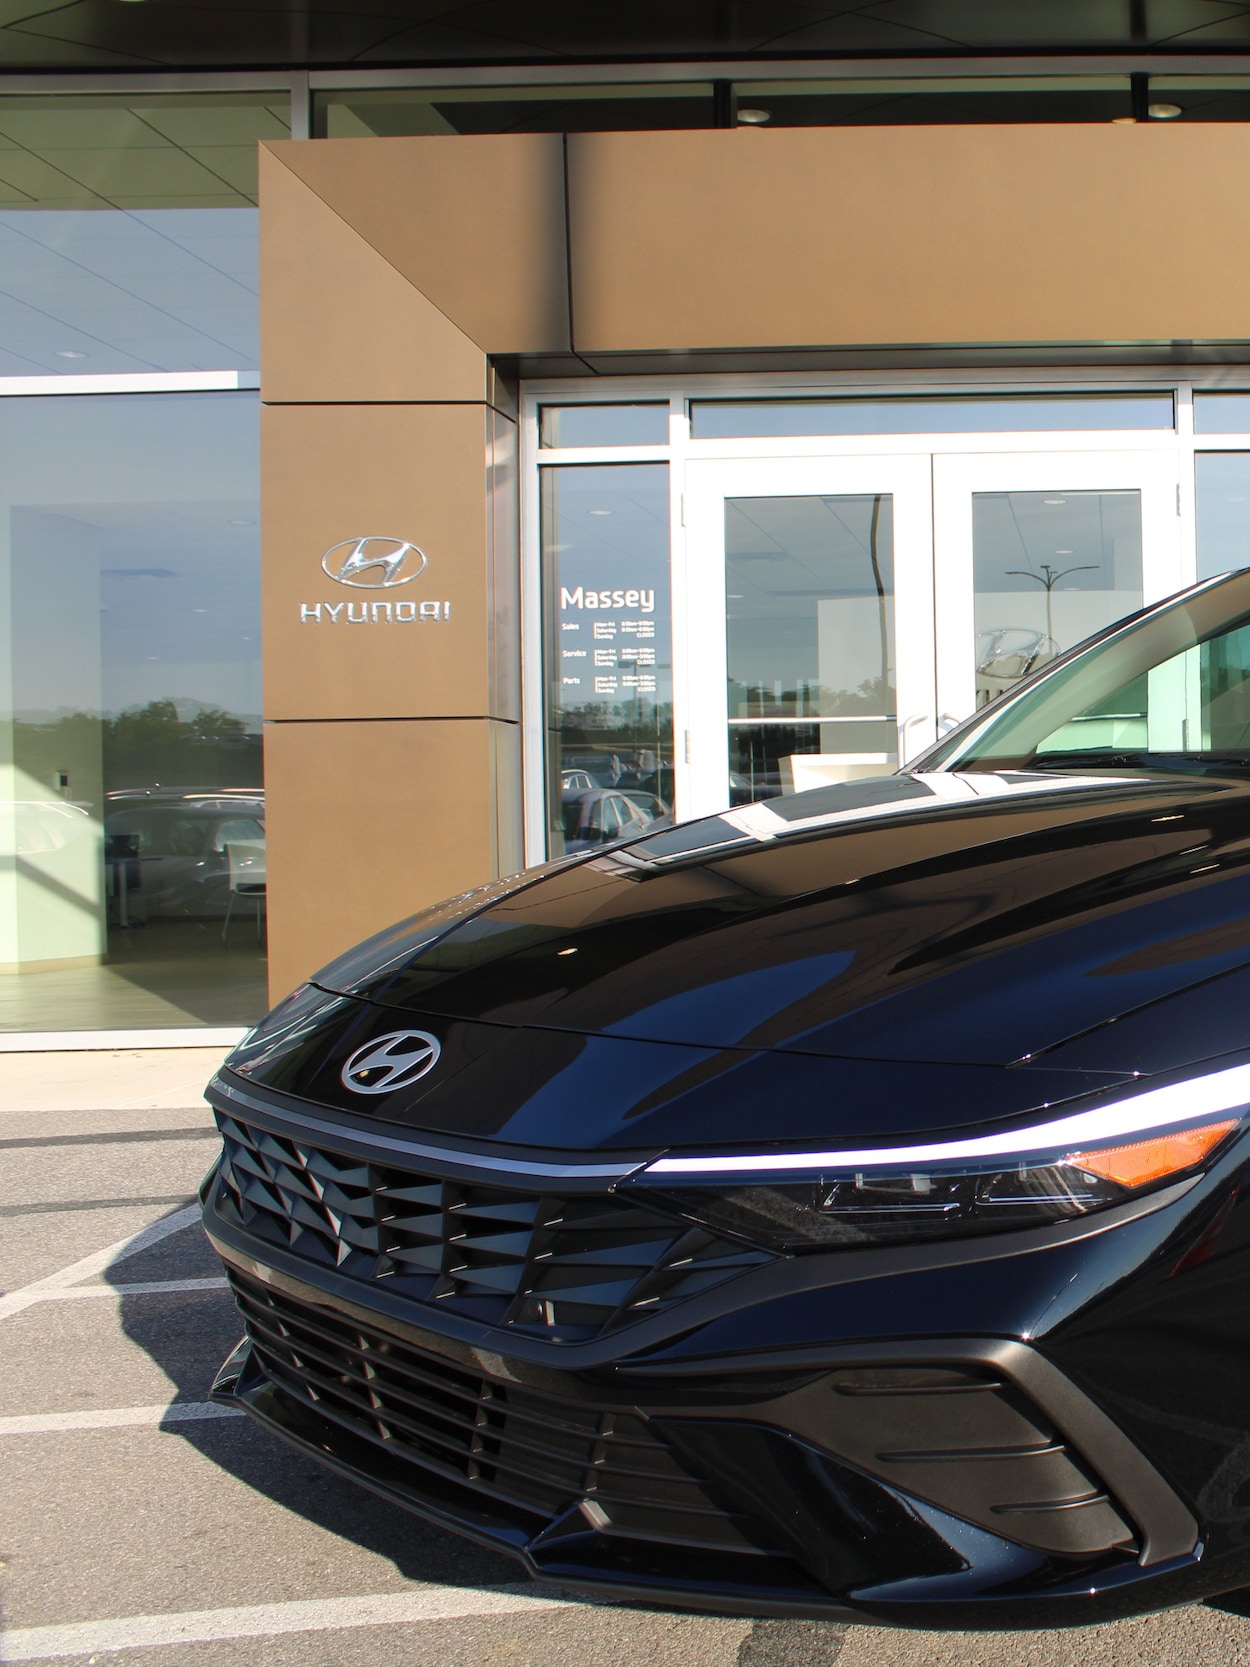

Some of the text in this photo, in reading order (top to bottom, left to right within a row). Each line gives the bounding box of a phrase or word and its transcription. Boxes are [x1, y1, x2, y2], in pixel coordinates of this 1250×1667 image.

[560, 586, 655, 613] Massey
[300, 601, 450, 624] HYUNDAI
[561, 623, 580, 631] Sales
[562, 649, 587, 658] Service
[563, 677, 581, 685] Parts
